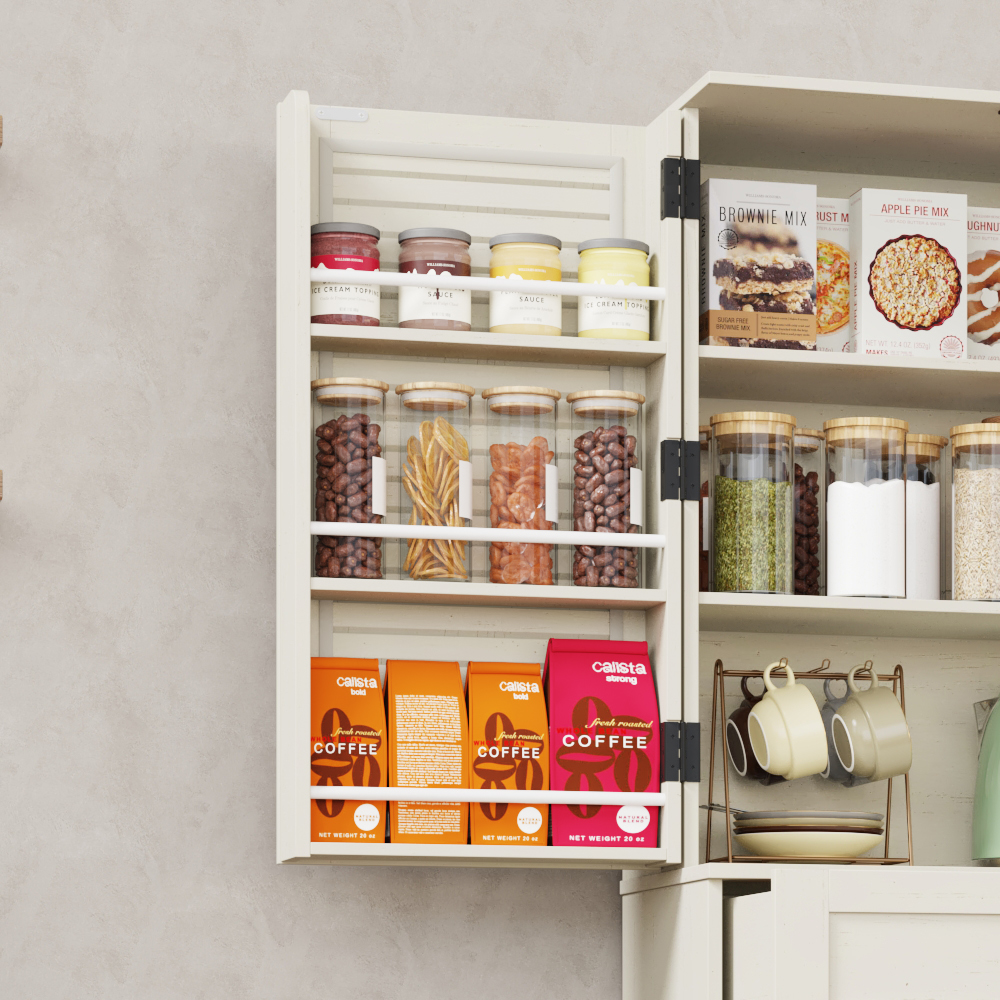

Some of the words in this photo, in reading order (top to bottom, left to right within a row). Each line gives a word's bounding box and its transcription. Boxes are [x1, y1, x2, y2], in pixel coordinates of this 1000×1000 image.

[881, 203, 911, 215] APPLE
[914, 205, 929, 216] PIE
[931, 206, 949, 217] MIX
[719, 206, 778, 225] BROWNIE
[785, 210, 807, 226] MIX
[716, 323, 740, 331] BROWNIE
[865, 339, 877, 347] NET
[605, 674, 638, 685] strong
[350, 688, 366, 696] bold
[584, 717, 616, 729] fresh
[617, 720, 654, 729] roasted
[330, 726, 354, 737] fresh
[354, 729, 382, 737] roasted
[494, 731, 517, 741] fresh
[517, 733, 545, 741] roasted
[556, 727, 594, 735] WHOLE
[598, 727, 627, 735] BEAN
[562, 734, 647, 749] COFFEE
[313, 742, 378, 755] COFFEE
[477, 746, 540, 759] COFFEE
[569, 834, 586, 842] NET
[588, 834, 622, 842] WEIGHT
